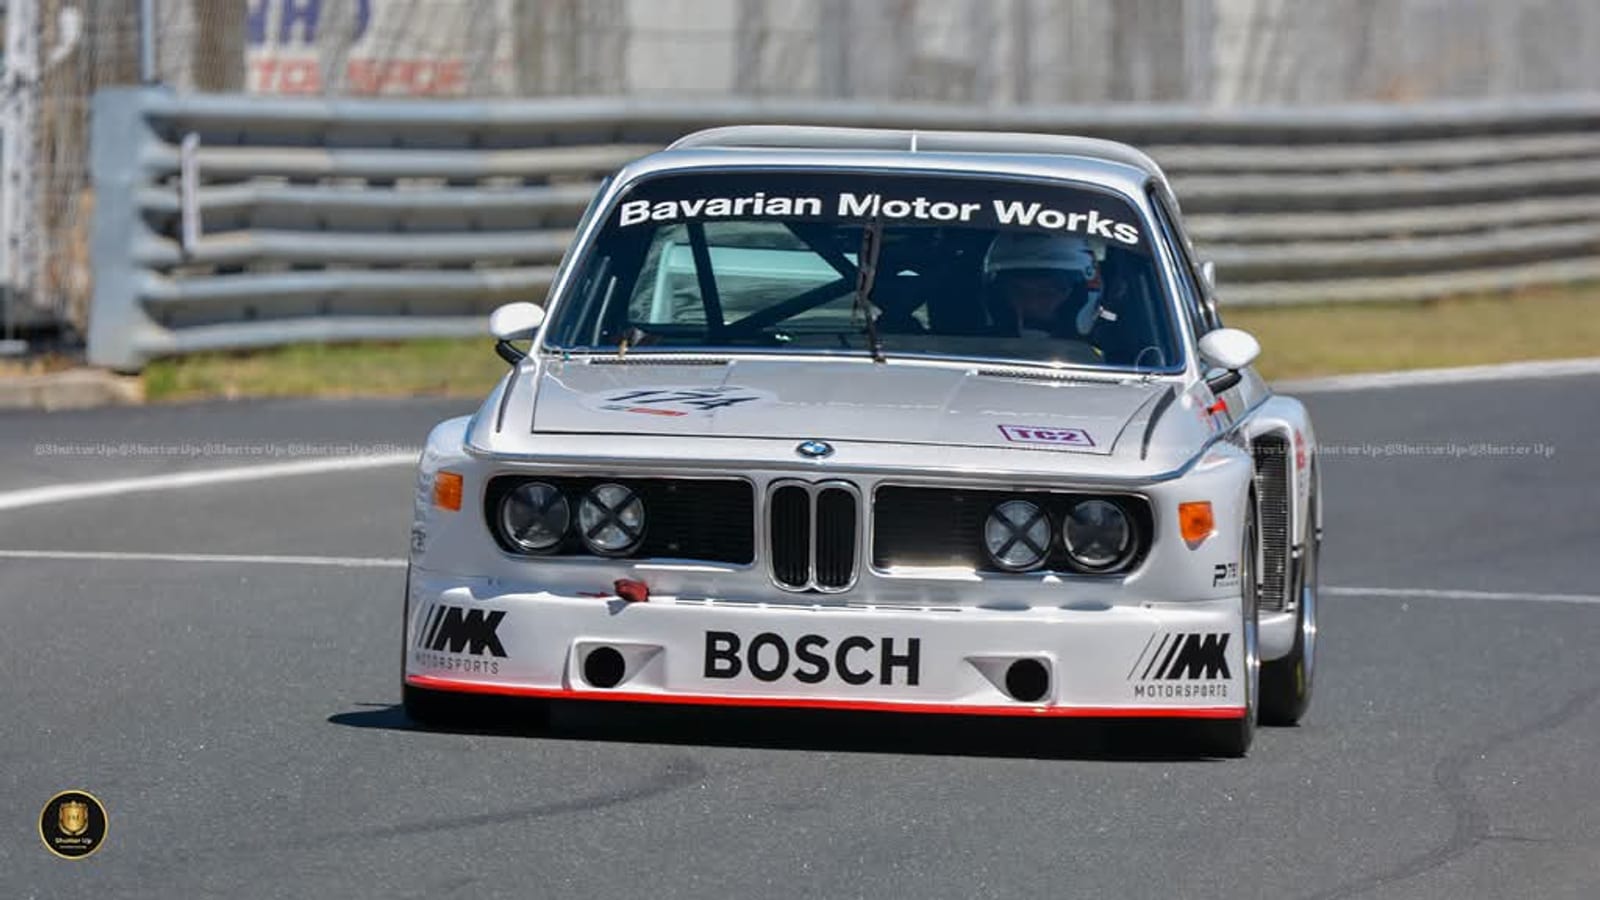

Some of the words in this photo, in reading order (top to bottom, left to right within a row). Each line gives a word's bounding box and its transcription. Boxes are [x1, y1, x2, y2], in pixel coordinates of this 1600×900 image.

[619, 192, 821, 227] Bavarian
[837, 193, 980, 221] Motor
[992, 199, 1139, 245] Works
[1011, 428, 1083, 442] TC2
[415, 652, 499, 675] MOTORSPORTS
[704, 631, 920, 686] BOSCH
[1134, 684, 1228, 698] MOTORSPORTS
